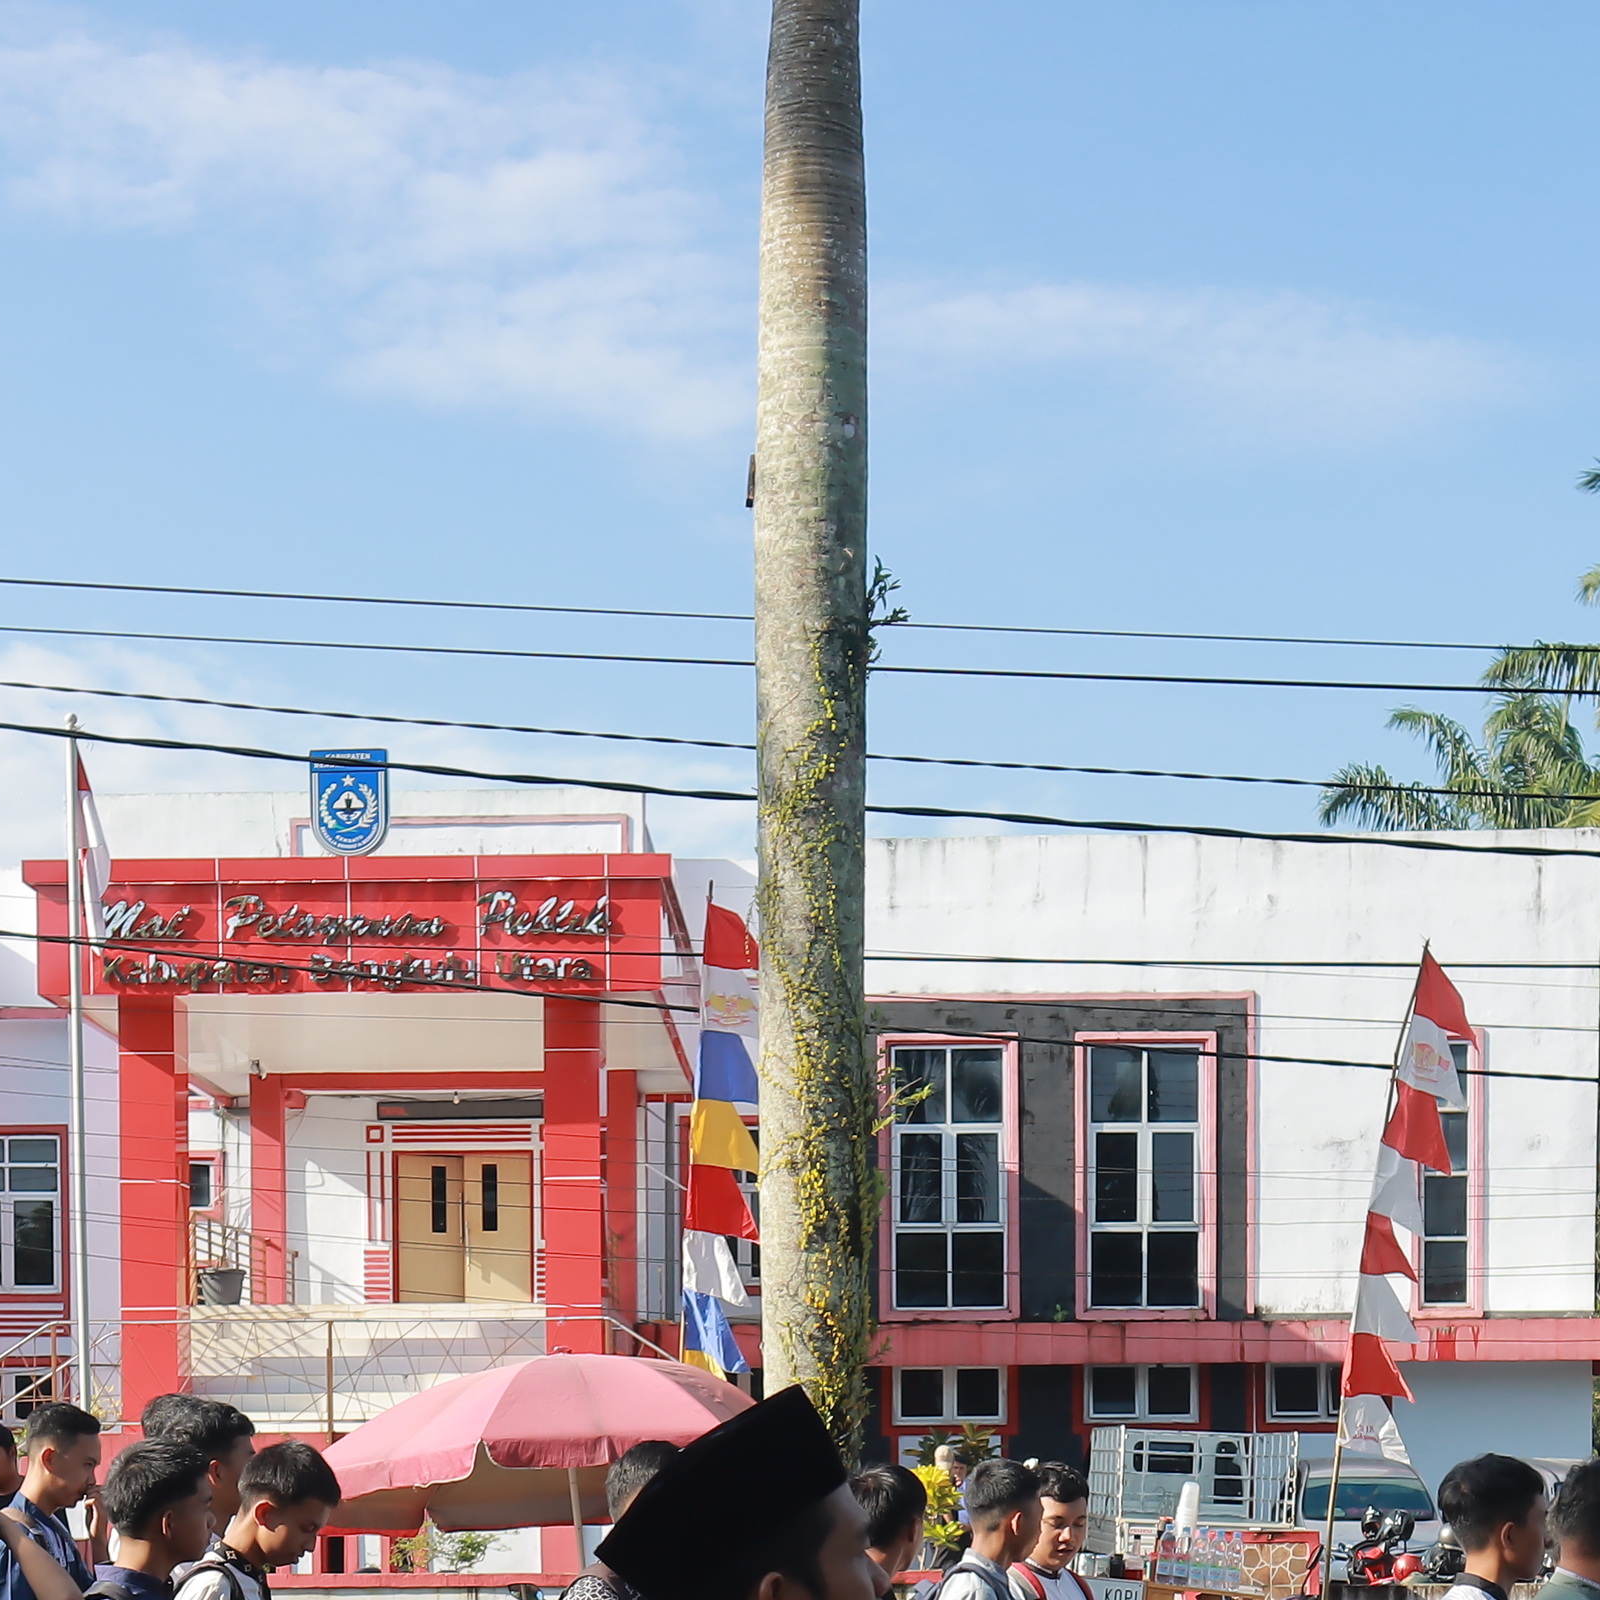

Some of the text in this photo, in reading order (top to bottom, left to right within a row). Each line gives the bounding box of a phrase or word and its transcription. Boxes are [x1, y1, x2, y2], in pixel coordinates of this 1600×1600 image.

[224, 893, 446, 945] Pelayanan
[476, 889, 613, 937] Publik
[102, 951, 592, 992] Kabupaten Bengkulu Utara
